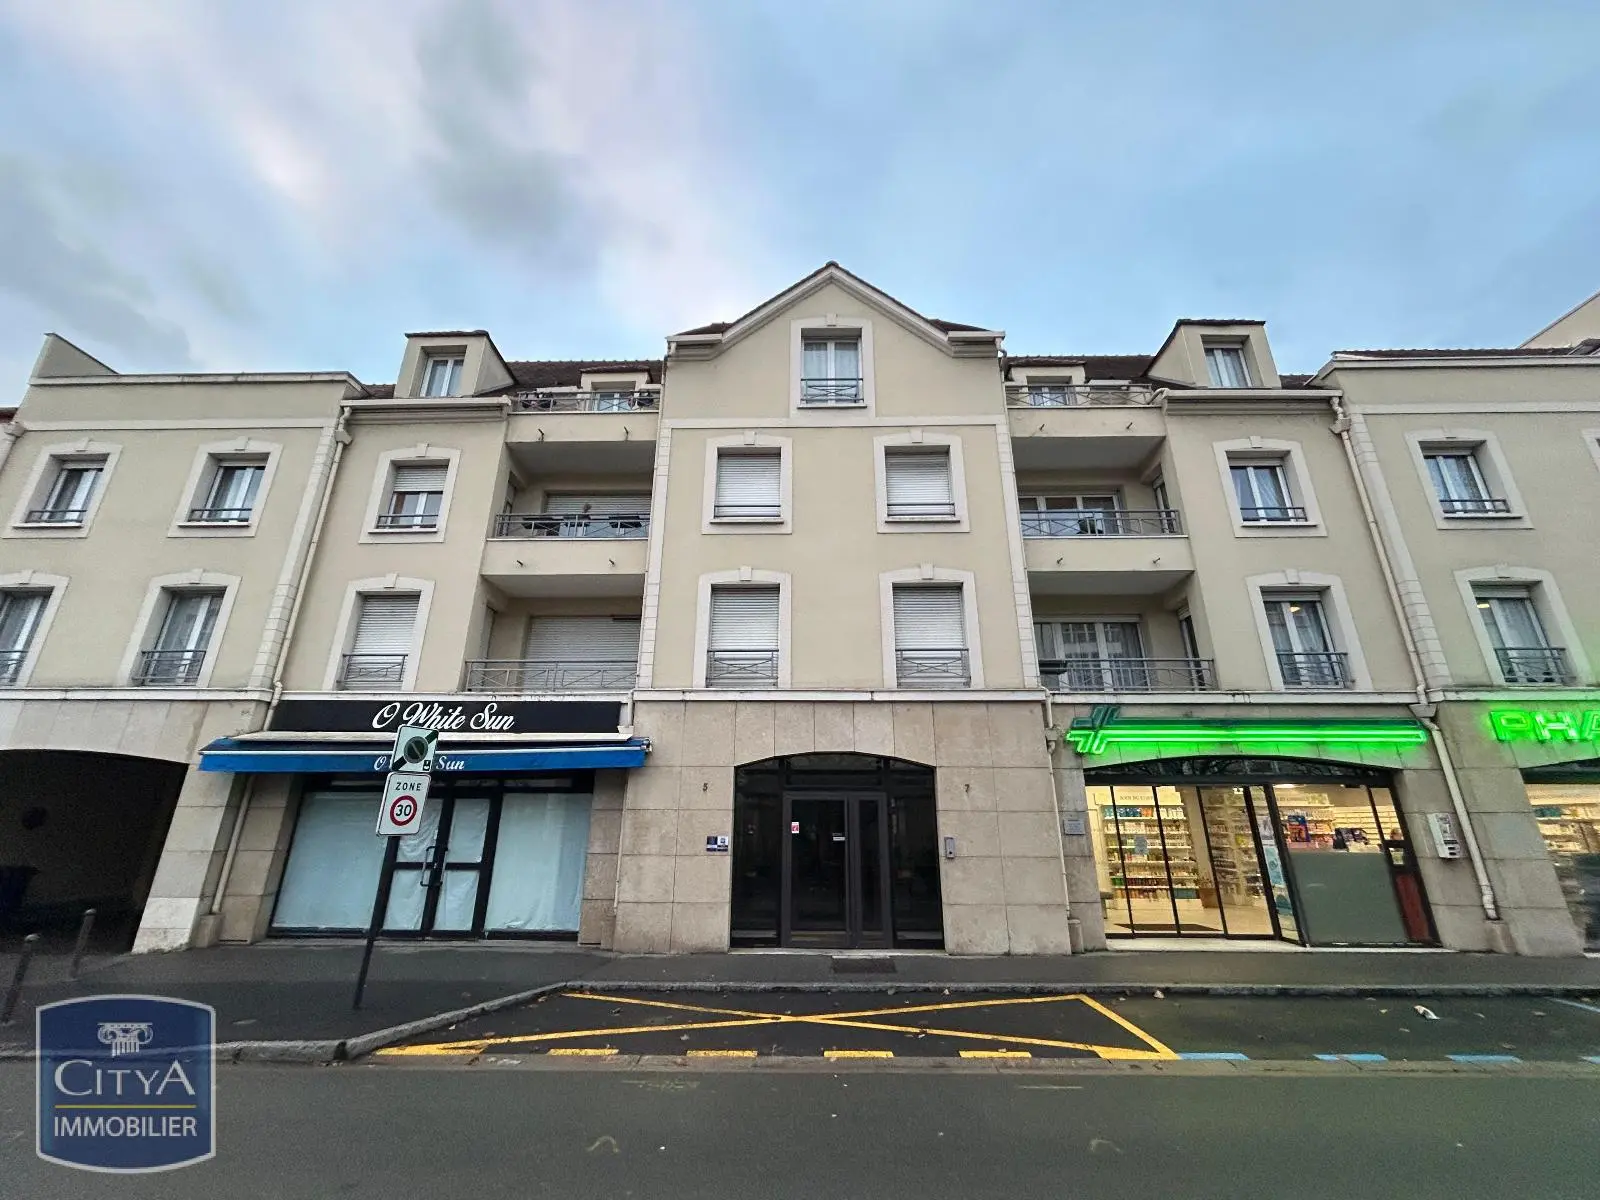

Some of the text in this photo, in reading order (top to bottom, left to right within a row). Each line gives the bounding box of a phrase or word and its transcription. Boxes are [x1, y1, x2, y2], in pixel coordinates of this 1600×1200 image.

[372, 702, 515, 731] O White Sun
[373, 755, 387, 771] O
[436, 755, 465, 770] Sun
[395, 782, 422, 791] ZONE
[395, 804, 412, 817] 30
